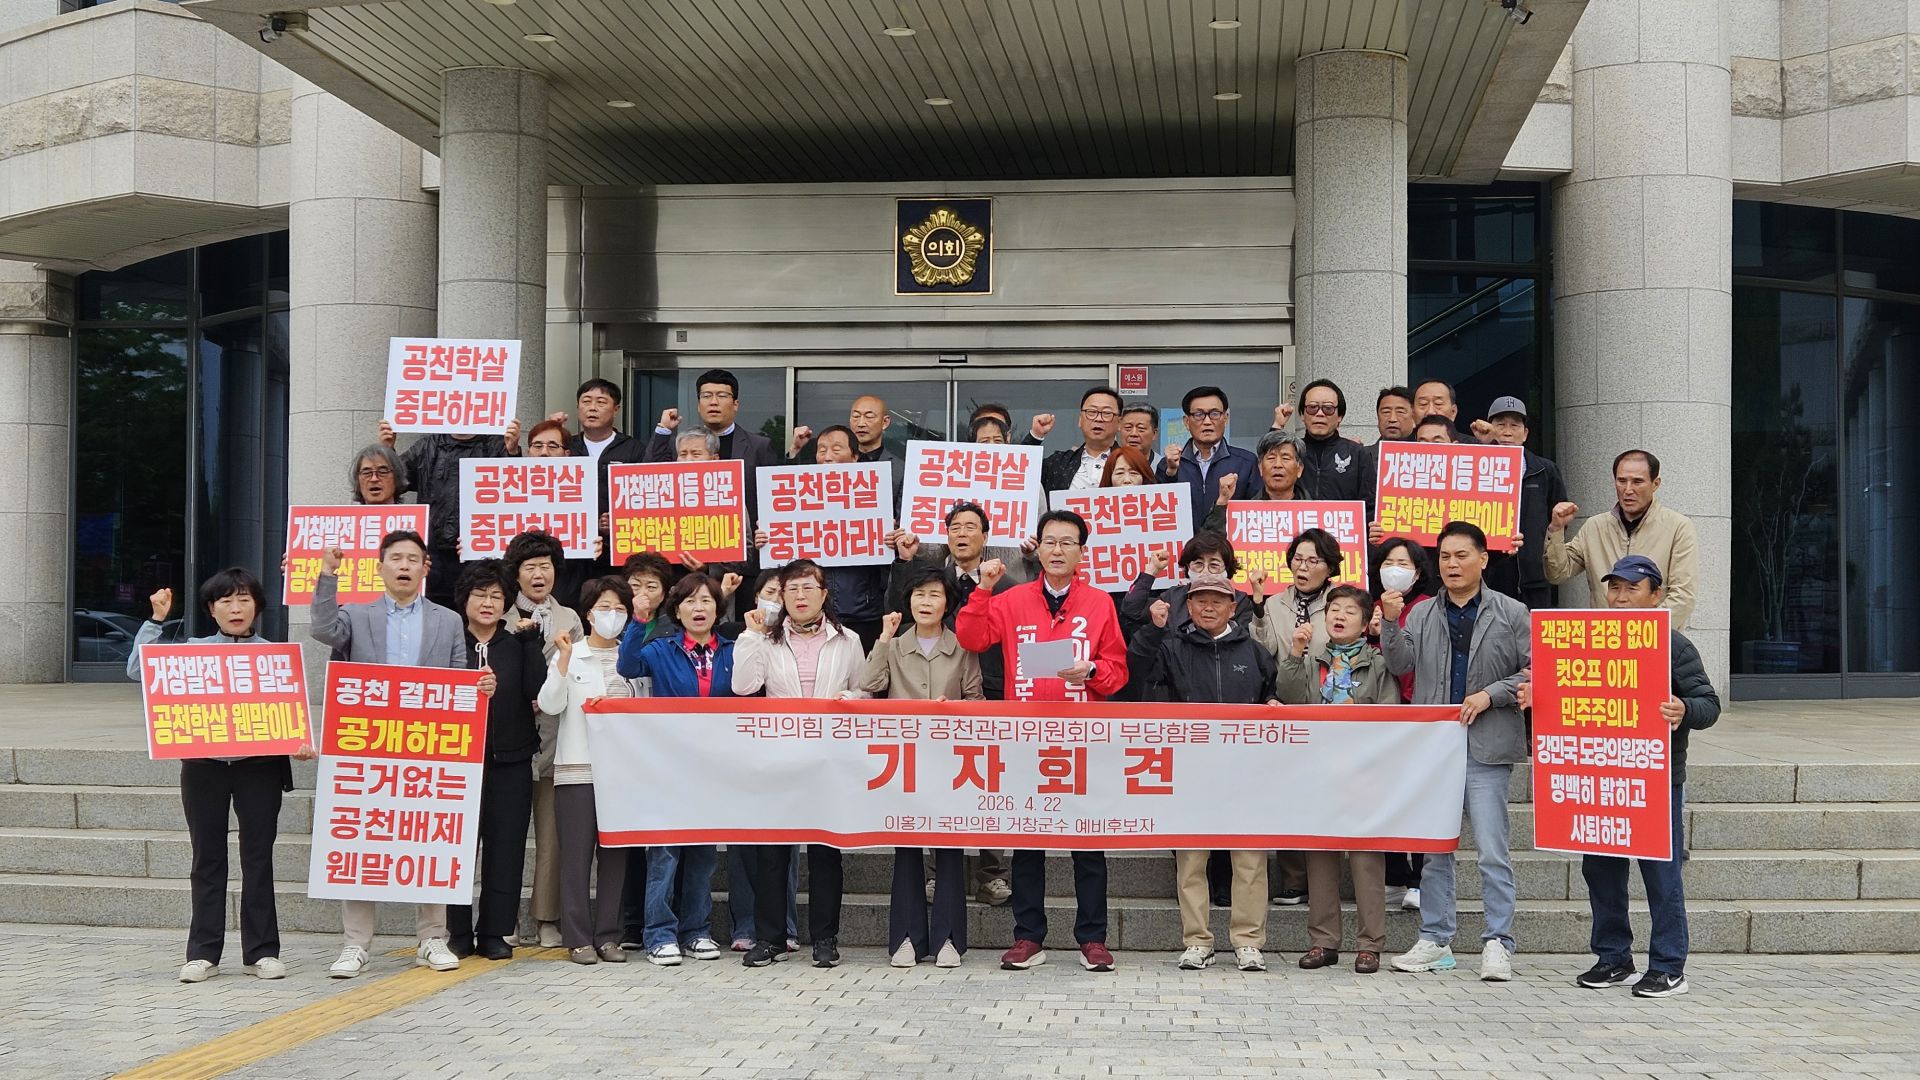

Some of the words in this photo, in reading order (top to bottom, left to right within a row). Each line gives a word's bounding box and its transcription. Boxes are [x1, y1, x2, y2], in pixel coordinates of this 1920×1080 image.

[926, 240, 960, 256] 의회
[402, 345, 508, 382] 공천학살
[1124, 374, 1143, 382] 에스원
[394, 389, 507, 427] 중단하라!
[474, 465, 584, 504] 공천학살
[919, 449, 1029, 491] 공천학살
[1382, 452, 1447, 490] 거창발전
[1451, 455, 1474, 491] 1등
[1478, 456, 1514, 494] 일꾼,
[614, 473, 674, 510] 거창발전
[678, 472, 699, 508] 1등
[703, 471, 737, 507] 일꾼,
[771, 470, 879, 512] 공천학살
[292, 515, 356, 550] 거창발전
[360, 516, 381, 550] 1등
[1232, 510, 1294, 543] 거창발전
[1323, 510, 1359, 544] 일꾼,
[1381, 496, 1446, 534] 공천학살
[615, 516, 676, 554] 공천학살
[680, 514, 740, 550] 웬말이냐
[769, 518, 884, 560] 중단하라!
[290, 558, 354, 593] 공천살
[1071, 616, 1088, 638] 2
[1540, 620, 1586, 650] 객관적
[1590, 620, 1622, 649] 검정
[1626, 620, 1658, 650] 없이
[147, 656, 223, 695] 거창발전
[226, 655, 252, 694] 1등
[256, 653, 299, 694] 일꾼,
[1556, 658, 1602, 688] 컷오프
[1606, 659, 1638, 688] 이게
[336, 678, 388, 707] 공천
[398, 681, 478, 713] 결과를
[1561, 697, 1638, 728] 민주주의냐
[152, 703, 229, 744] 공천학살
[232, 701, 306, 742] 웬말이냐
[336, 717, 472, 756] 공개하라
[736, 716, 823, 739] 국민의힘
[831, 717, 922, 740] 경남도당
[928, 718, 1110, 744] 공천관리위원회의
[1120, 721, 1211, 744] 부당함을
[1219, 722, 1310, 744] 규탄하는
[1536, 735, 1578, 766] 강민국
[1580, 737, 1664, 770] 도당의원장은
[332, 761, 467, 801] 근거없는
[1550, 774, 1595, 805] 명백히
[1600, 777, 1647, 808] 밝히고
[978, 795, 1018, 811] 2026.
[1024, 796, 1037, 812] 4.
[1044, 796, 1062, 812] 22
[328, 806, 464, 845] 공천배제
[884, 815, 932, 832] 이홍기
[938, 816, 1000, 832] 국민의힘
[1006, 817, 1069, 833] 거창군수
[1074, 818, 1155, 834] 예비후보자
[1570, 814, 1632, 847] 사퇴하라
[326, 851, 460, 890] 웬말이냐
